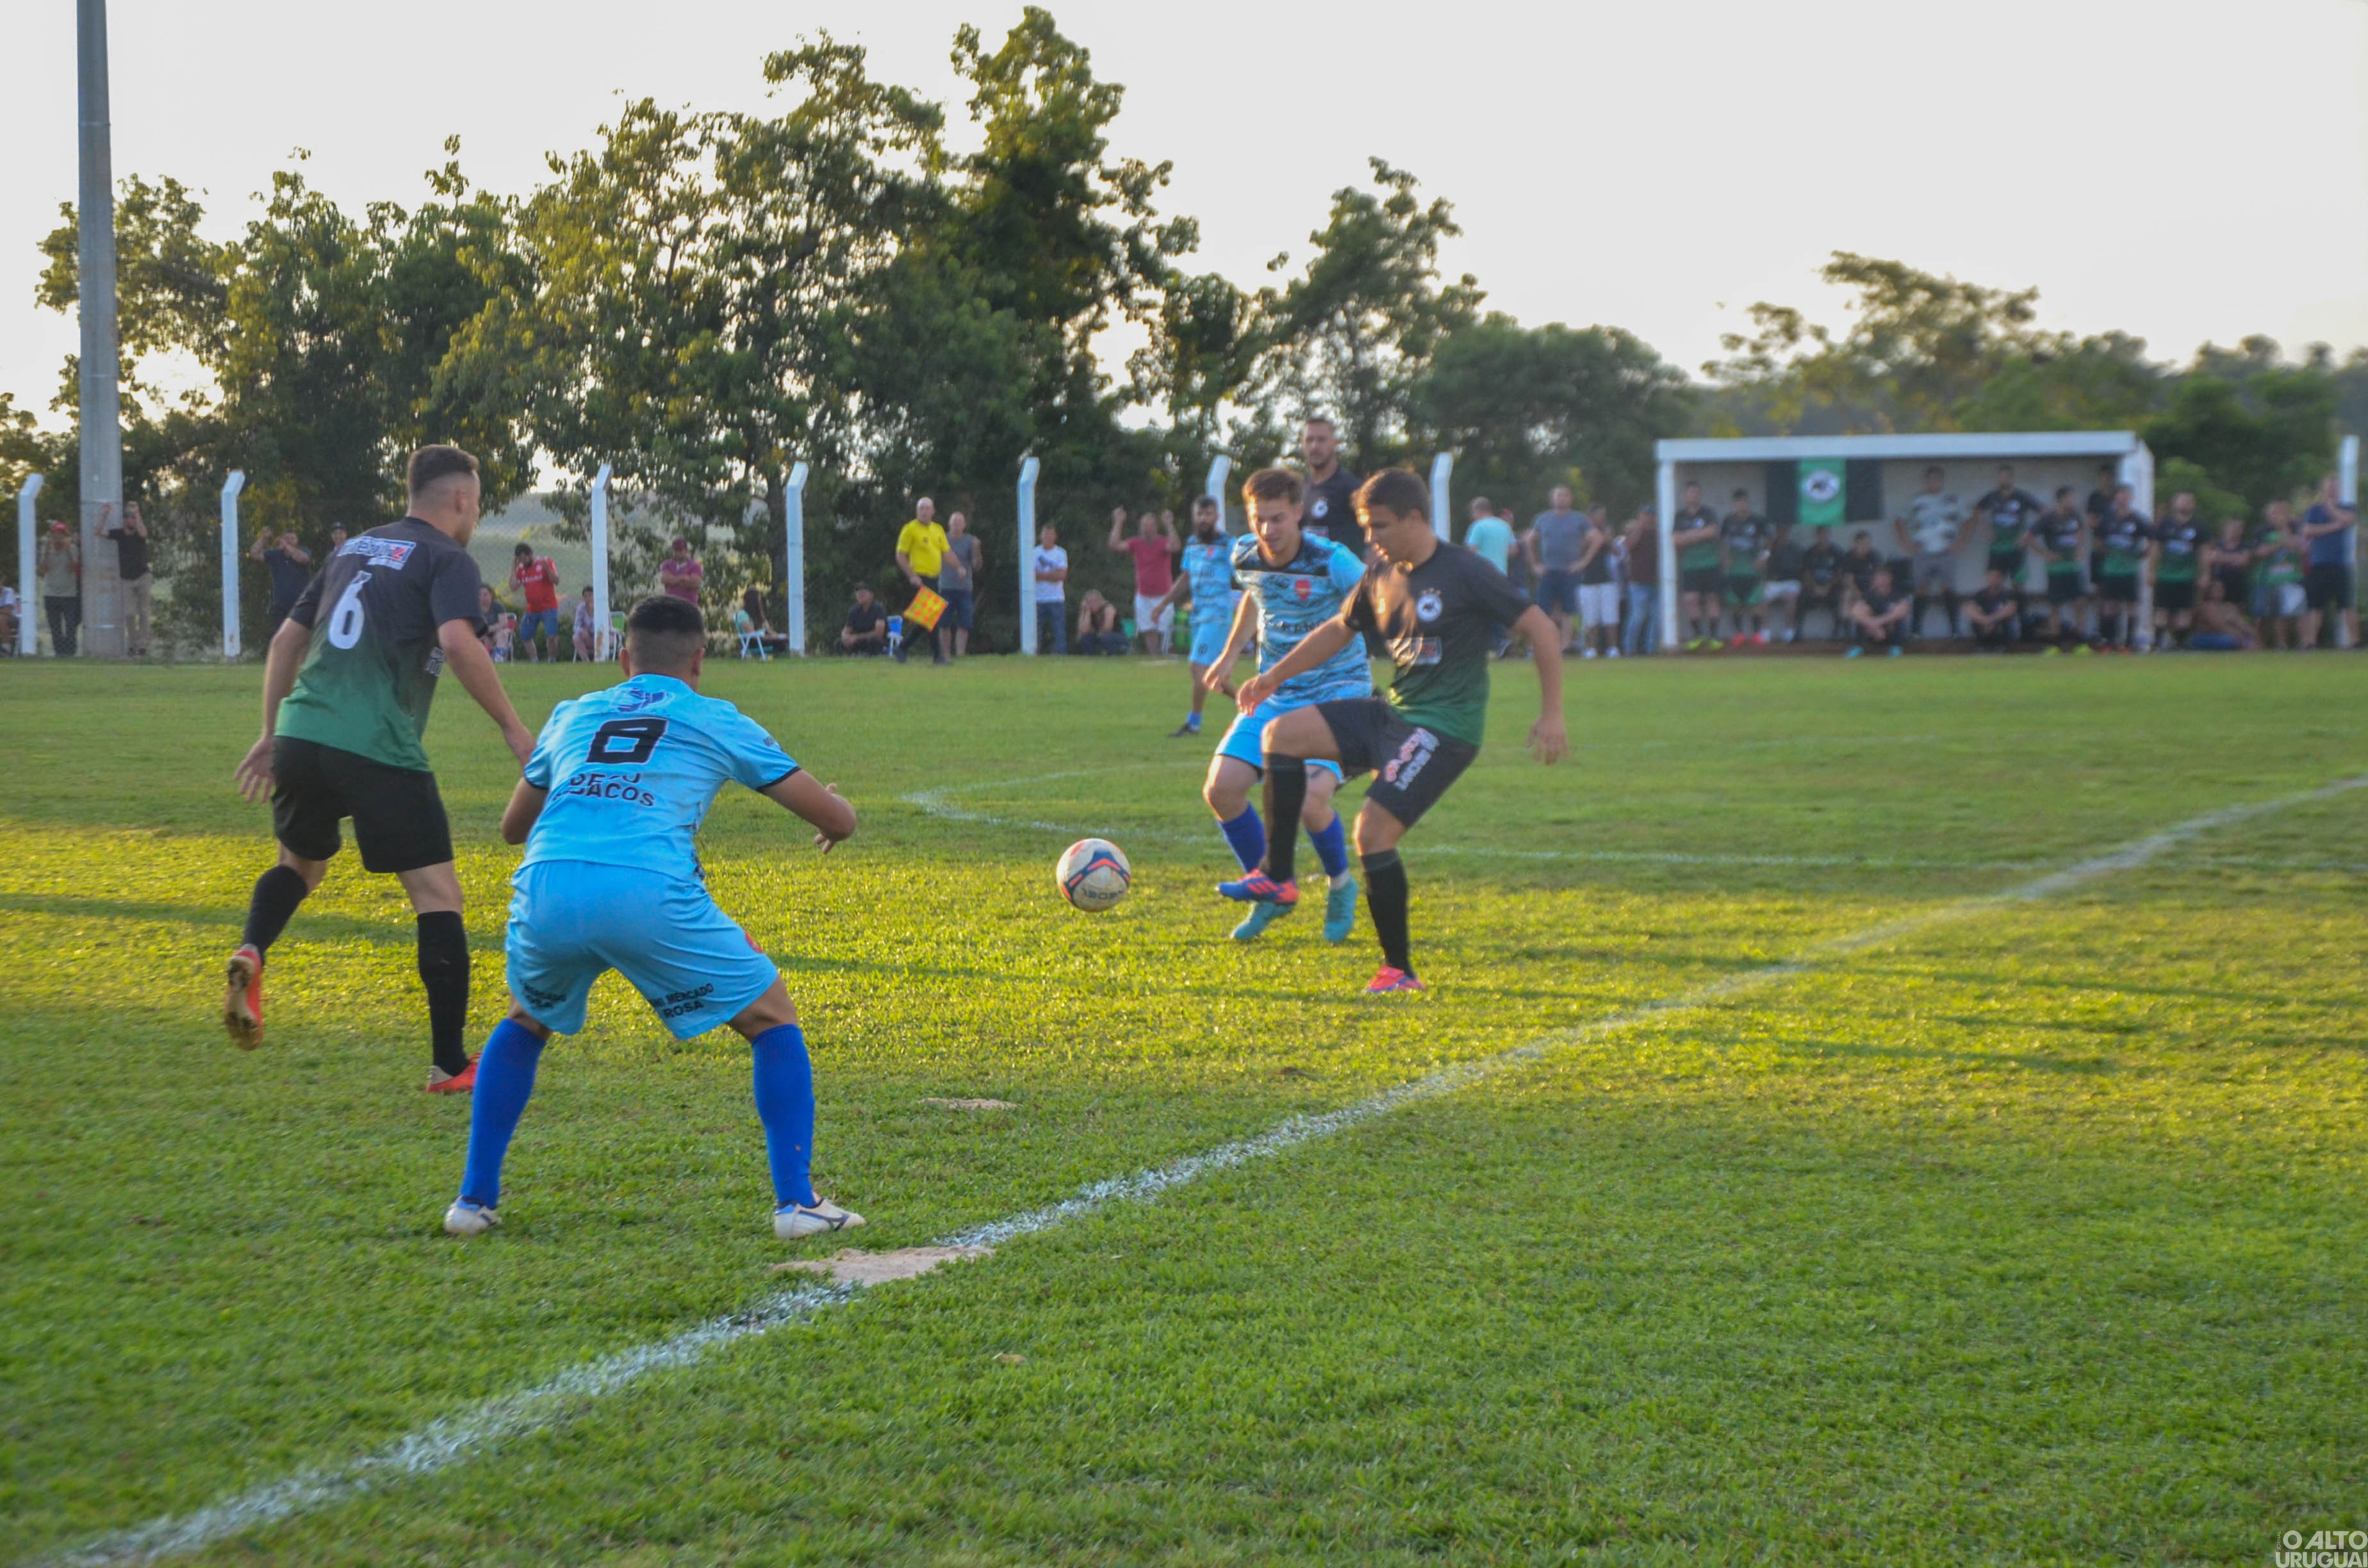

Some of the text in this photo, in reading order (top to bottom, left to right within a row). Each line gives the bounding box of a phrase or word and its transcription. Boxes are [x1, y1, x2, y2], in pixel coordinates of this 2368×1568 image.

[329, 570, 372, 649] 6
[585, 717, 669, 764] 8
[664, 1000, 704, 1018] ROSA
[666, 983, 714, 1005] MERCADO
